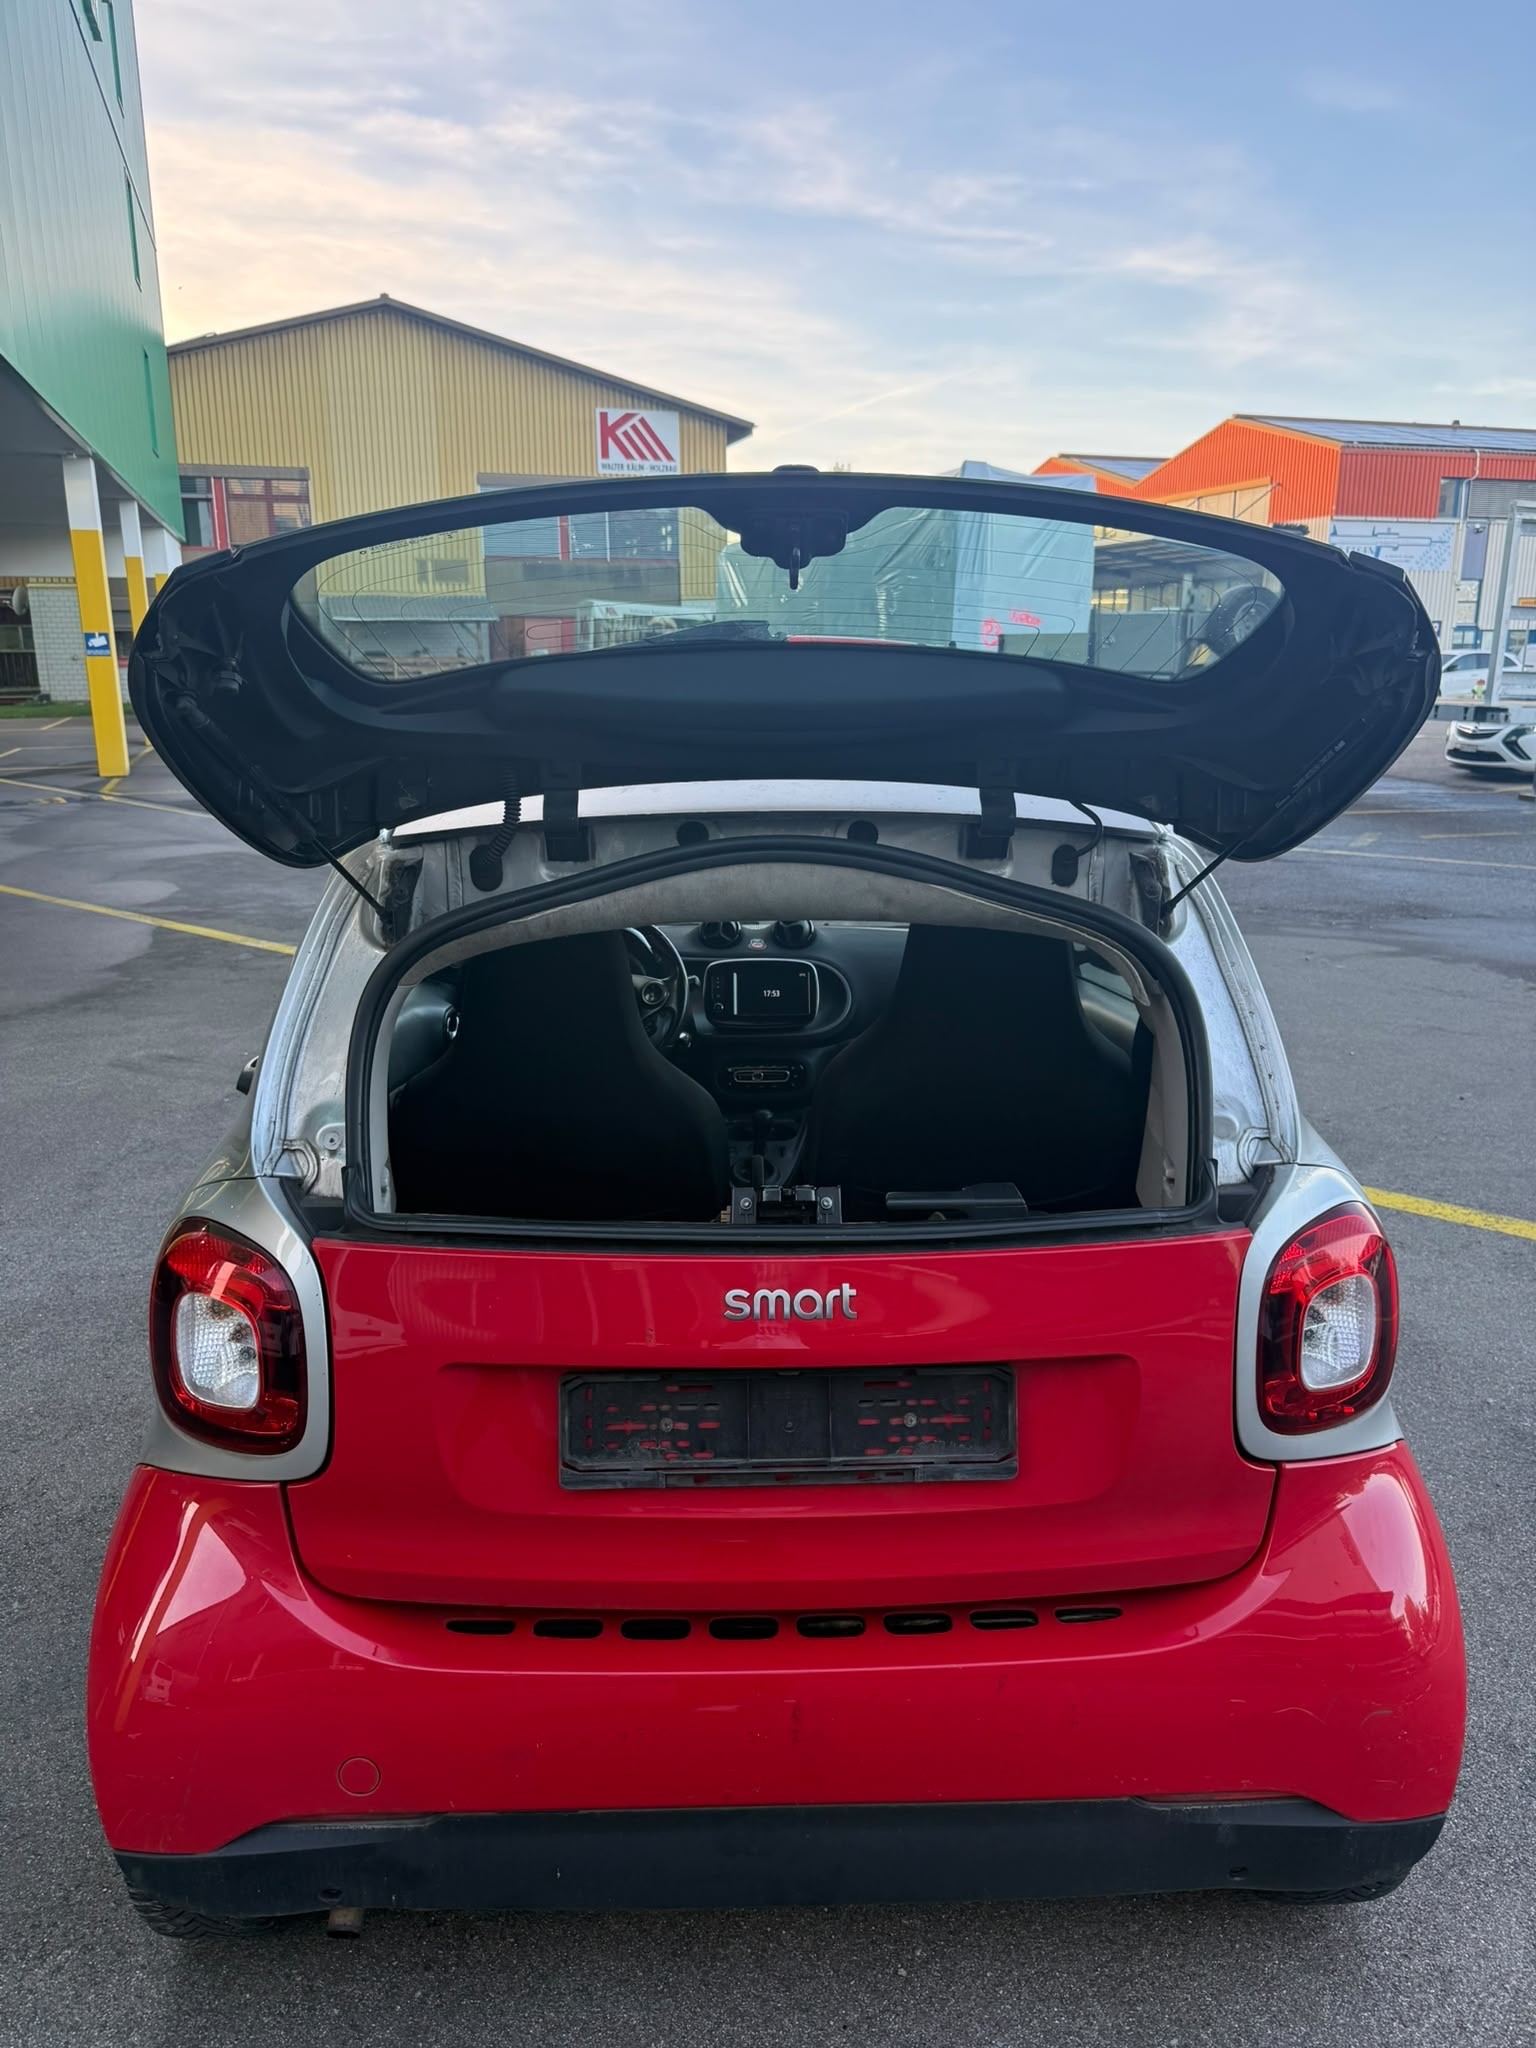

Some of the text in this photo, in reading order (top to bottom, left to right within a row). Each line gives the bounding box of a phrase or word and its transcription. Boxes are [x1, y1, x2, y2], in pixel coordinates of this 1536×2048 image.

[601, 463, 624, 471] WALTER
[650, 464, 677, 473] HOLZBAU
[763, 990, 780, 998] 17:53
[724, 1283, 858, 1321] smart
